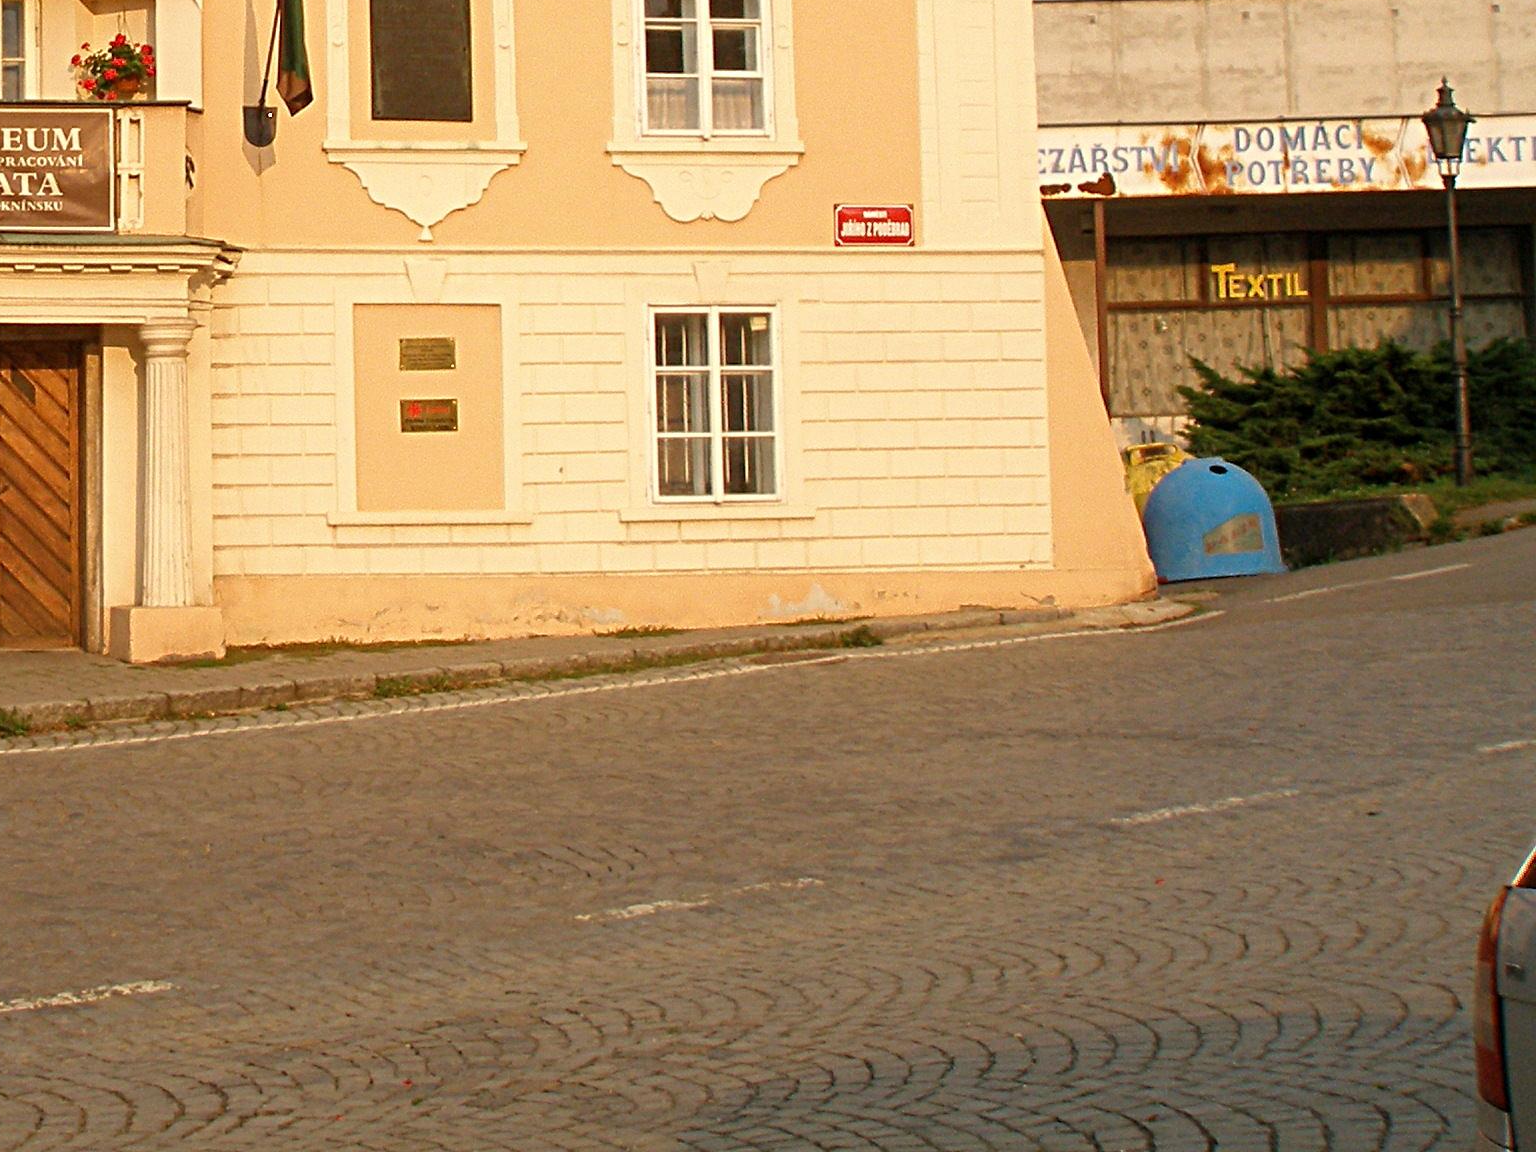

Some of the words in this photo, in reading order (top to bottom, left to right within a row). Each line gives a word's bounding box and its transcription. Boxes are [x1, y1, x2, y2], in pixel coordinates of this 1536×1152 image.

[1234, 120, 1363, 152] DOMÁCÍ
[1225, 155, 1376, 186] POTŘEBY
[1211, 263, 1309, 298] TEXTIL
